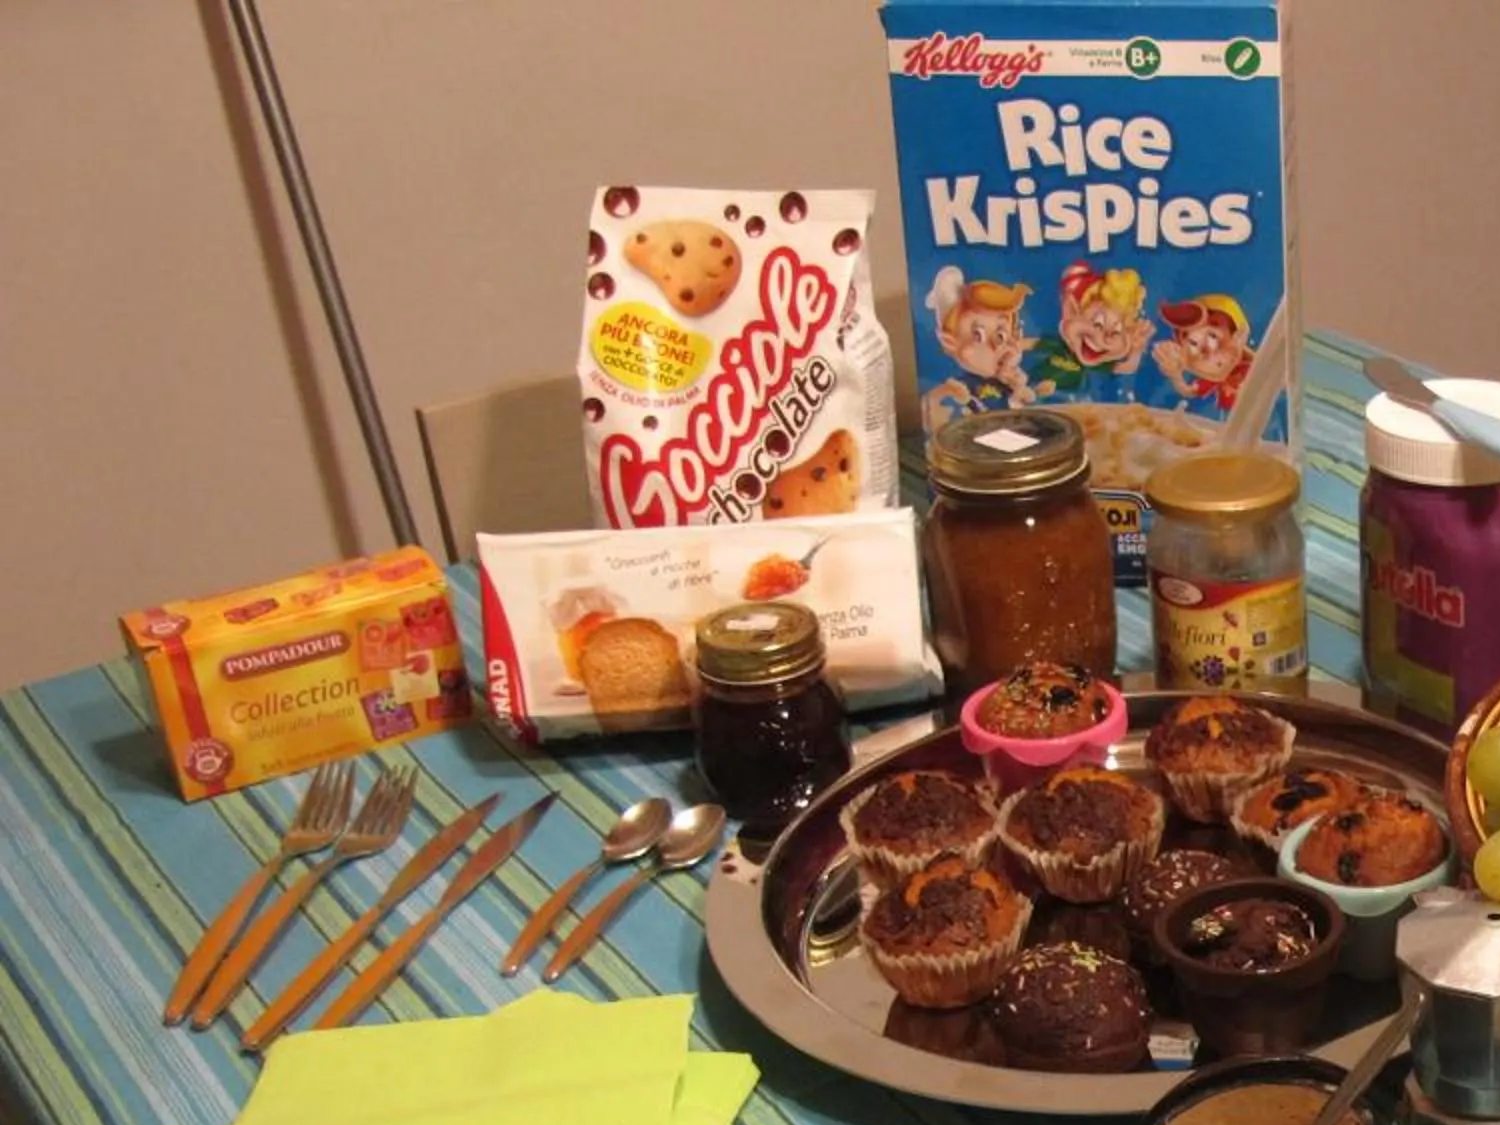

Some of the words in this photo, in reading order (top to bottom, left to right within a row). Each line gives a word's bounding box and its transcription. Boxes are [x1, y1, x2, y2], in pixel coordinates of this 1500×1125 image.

[903, 33, 1044, 88] Kellogg's
[1130, 47, 1159, 68] B+
[997, 98, 1172, 176] Rice
[925, 175, 1253, 253] Krispies
[617, 313, 689, 347] ANCORA
[631, 332, 696, 367] BONE!
[600, 245, 837, 530] Gocciole
[818, 608, 848, 626] enza
[224, 633, 343, 676] POMPADOUR
[230, 678, 360, 724] Collection
[488, 659, 513, 719] NAD
